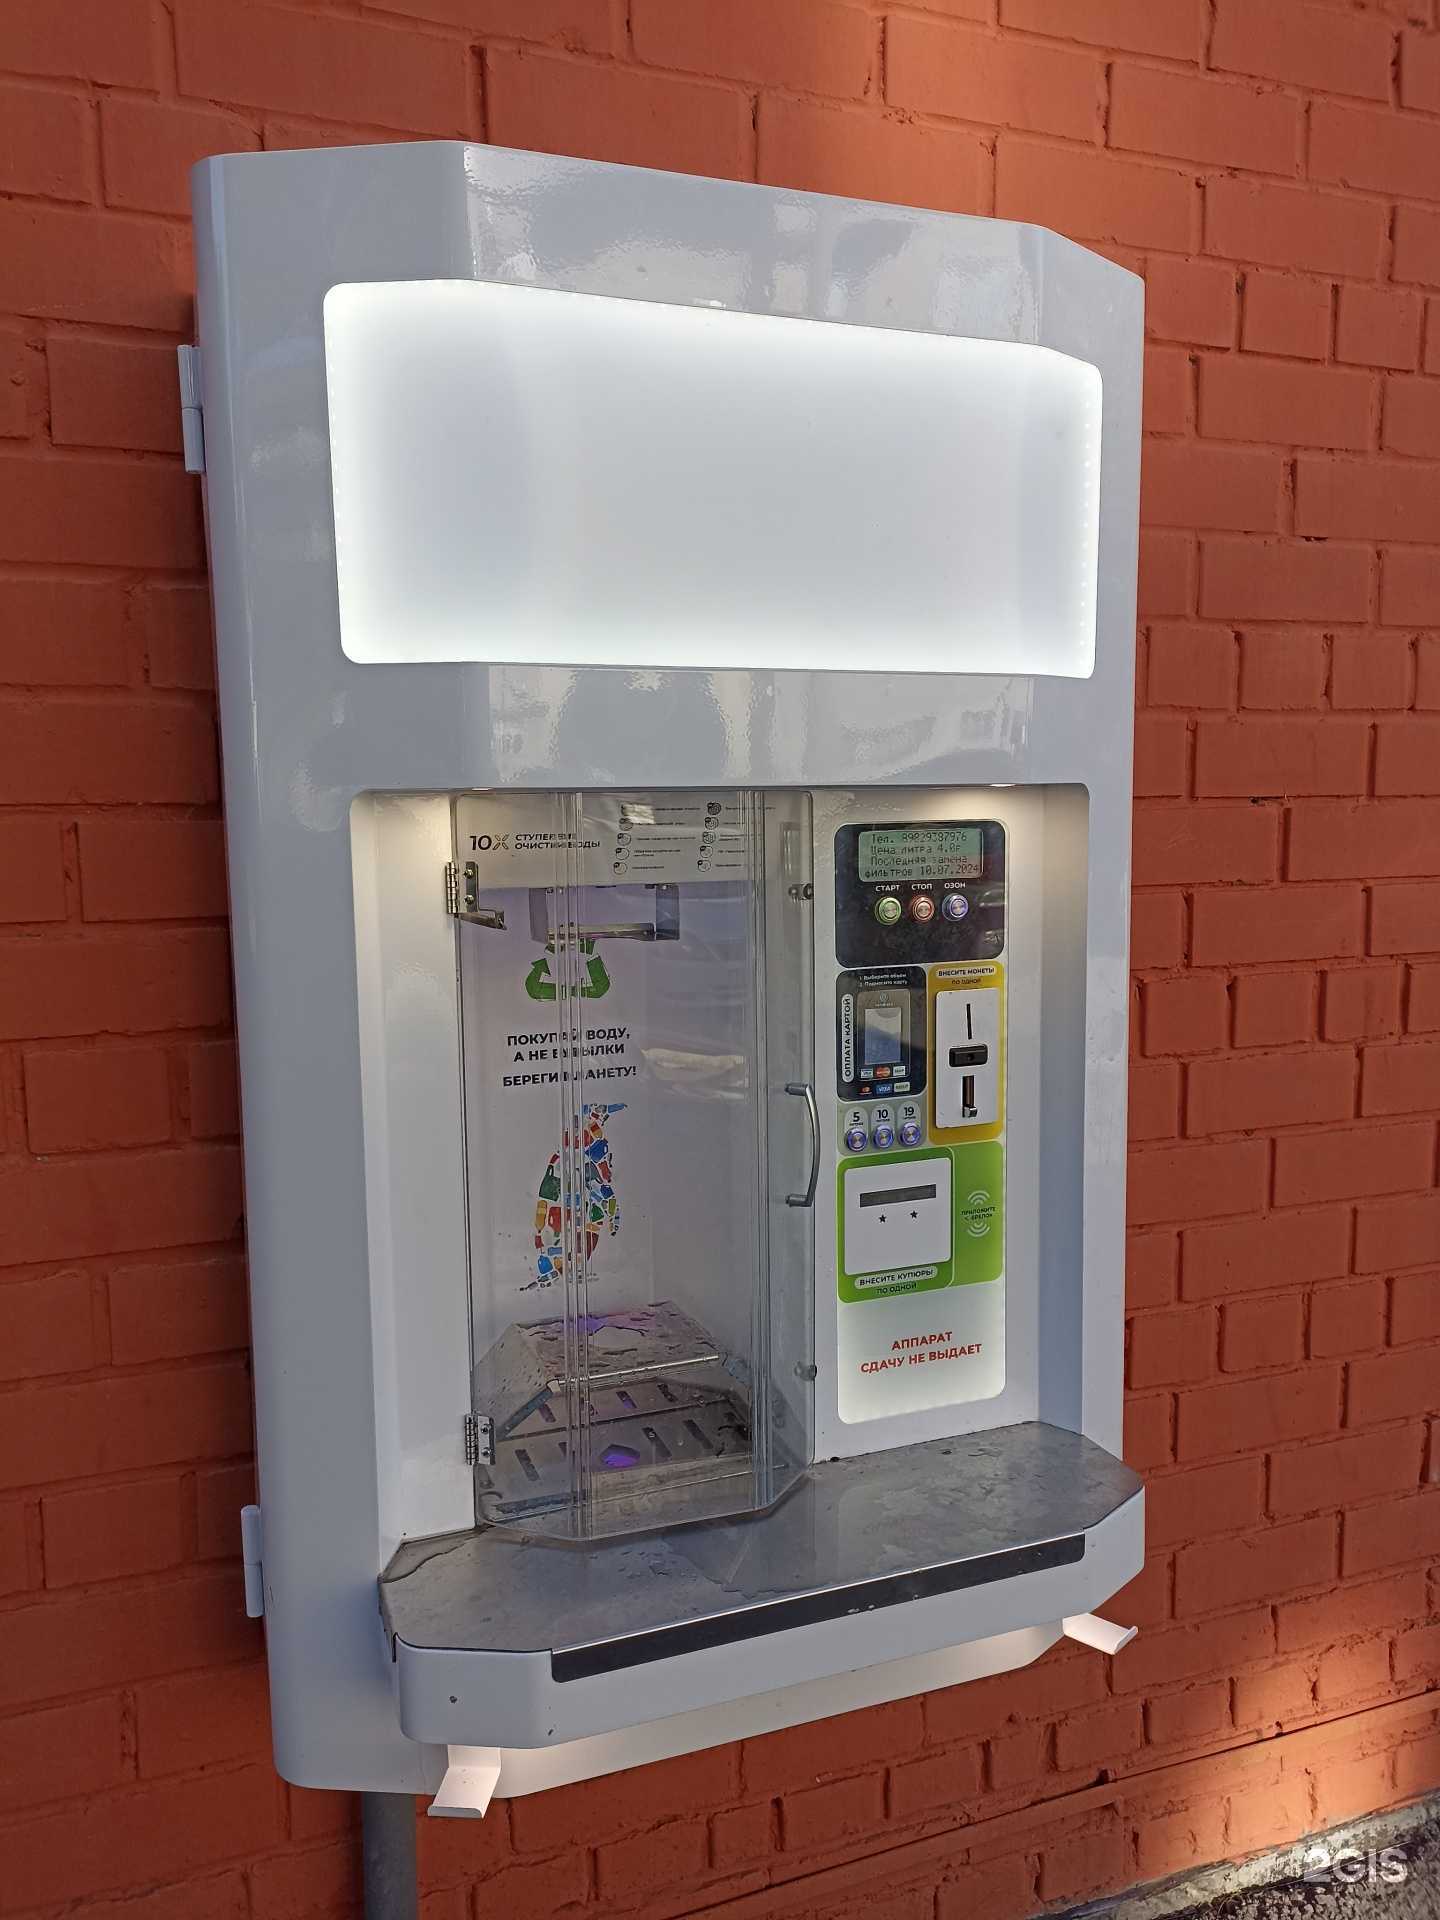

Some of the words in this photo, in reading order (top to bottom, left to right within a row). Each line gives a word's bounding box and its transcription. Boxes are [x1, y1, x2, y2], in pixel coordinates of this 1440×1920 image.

[871, 845, 896, 855] Цена
[871, 856, 926, 866] Последняя
[875, 884, 900, 892] СТАРТ
[911, 883, 933, 891] СТОП
[968, 967, 994, 975] МОНЕТЫ
[843, 998, 851, 1035] КАРТОЙ
[587, 1027, 630, 1041] ВОДУ,
[513, 1051, 525, 1062] А
[528, 1049, 548, 1061] НЕ
[503, 1072, 559, 1087] БЕРЕГИ
[853, 1111, 860, 1122] 5
[877, 1109, 888, 1119] 10
[904, 1106, 914, 1116] 19
[859, 1274, 895, 1286] ВНЕСИТЕ
[897, 1269, 933, 1281] КУПЮРЫ
[889, 1282, 917, 1293] ОДНОЙ
[891, 1332, 952, 1350] АППАРАТ
[861, 1358, 905, 1374] СДАЧУ
[908, 1353, 925, 1365] НЕ
[928, 1343, 982, 1362] ВЫДАЕТ
